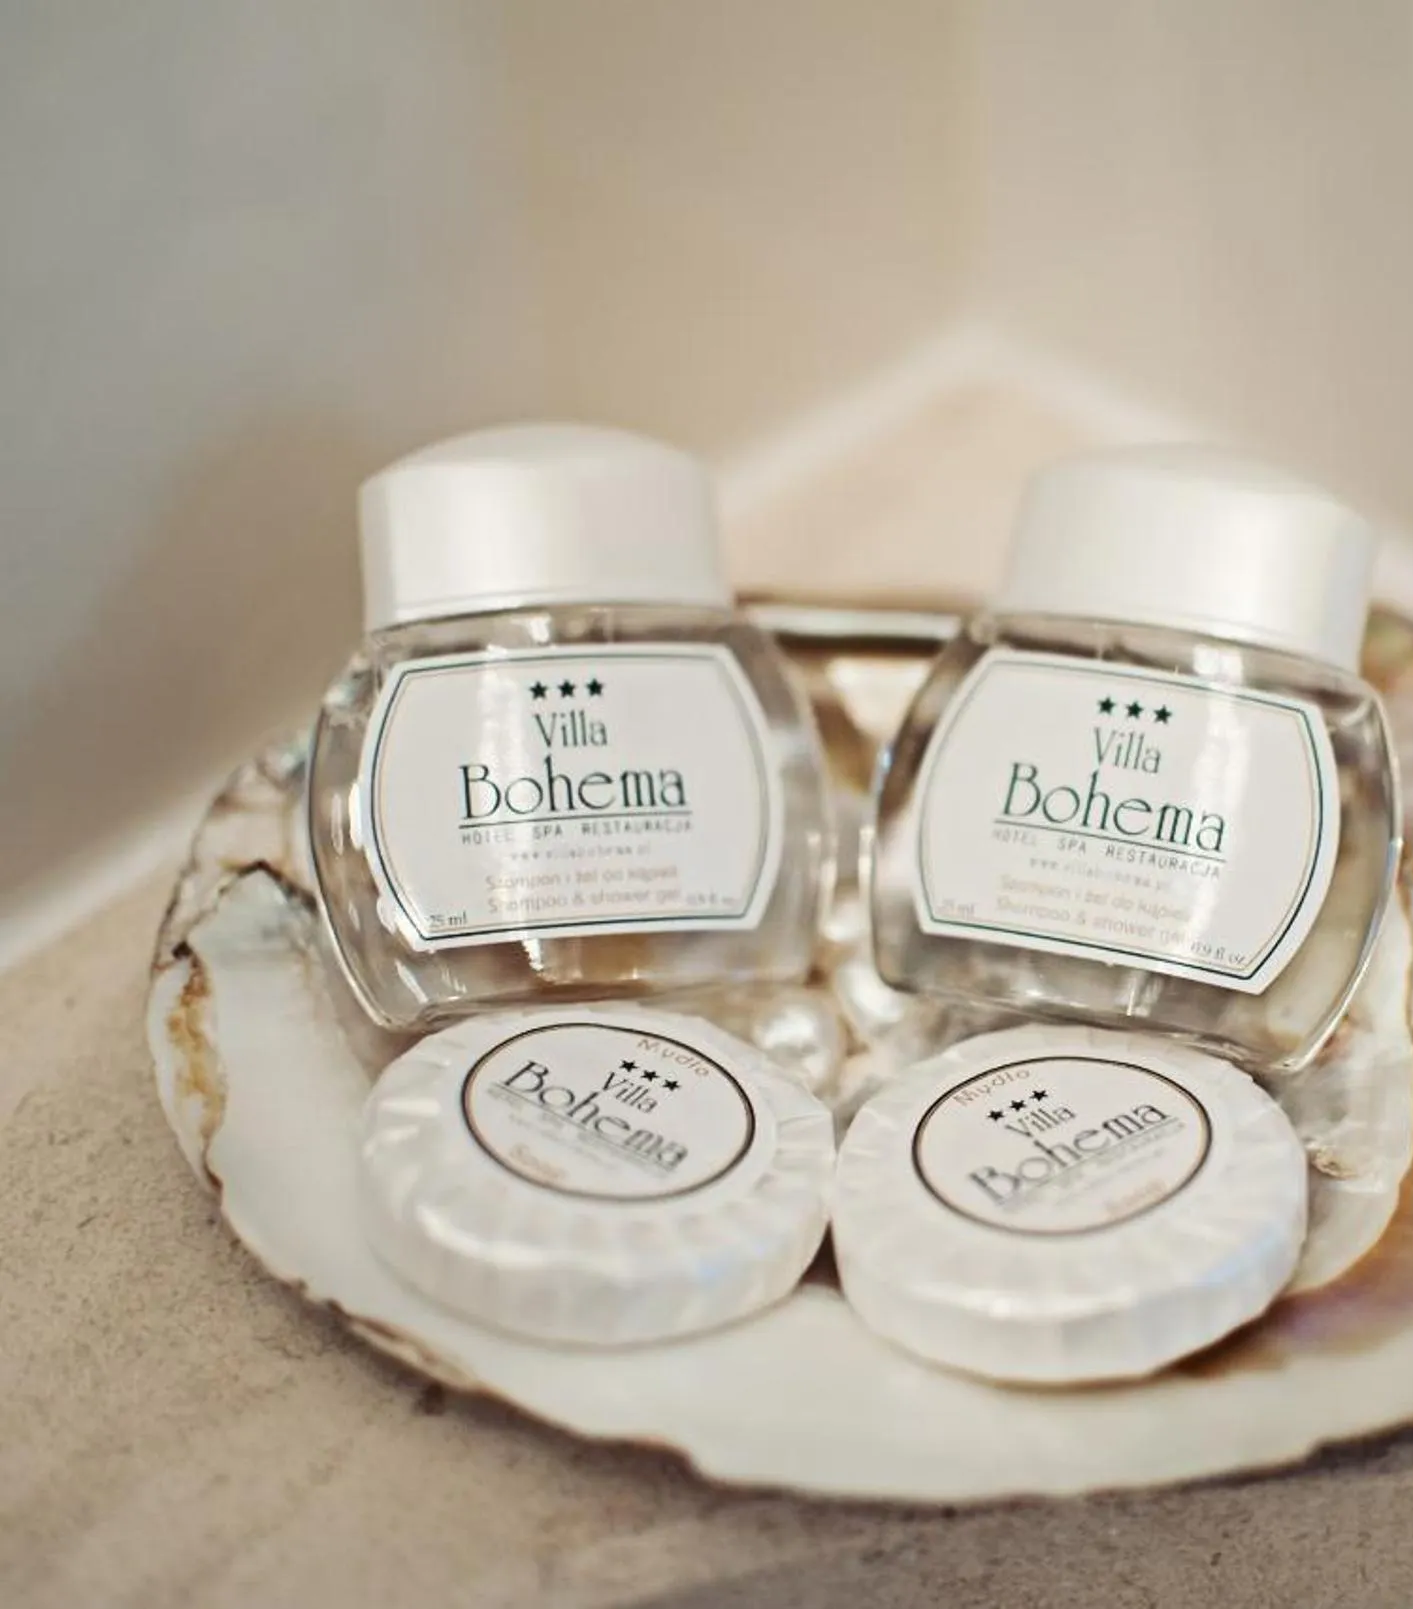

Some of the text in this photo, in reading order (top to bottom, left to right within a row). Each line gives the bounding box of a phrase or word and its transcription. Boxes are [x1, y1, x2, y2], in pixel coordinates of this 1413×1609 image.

[533, 709, 608, 748] Villa
[1092, 727, 1161, 774] Villa
[458, 754, 688, 819] Bohema
[1002, 761, 1226, 853] Bohema
[531, 825, 564, 841] SPA
[580, 820, 694, 838] RESTAURACJA
[992, 828, 1221, 880] HOTEL SPA RESTAURACJA
[448, 912, 467, 926] ml
[503, 1060, 690, 1168] Bohema
[602, 1071, 659, 1113] Villa
[1004, 1105, 1077, 1138] Villa
[968, 1103, 1168, 1204] Bohema
